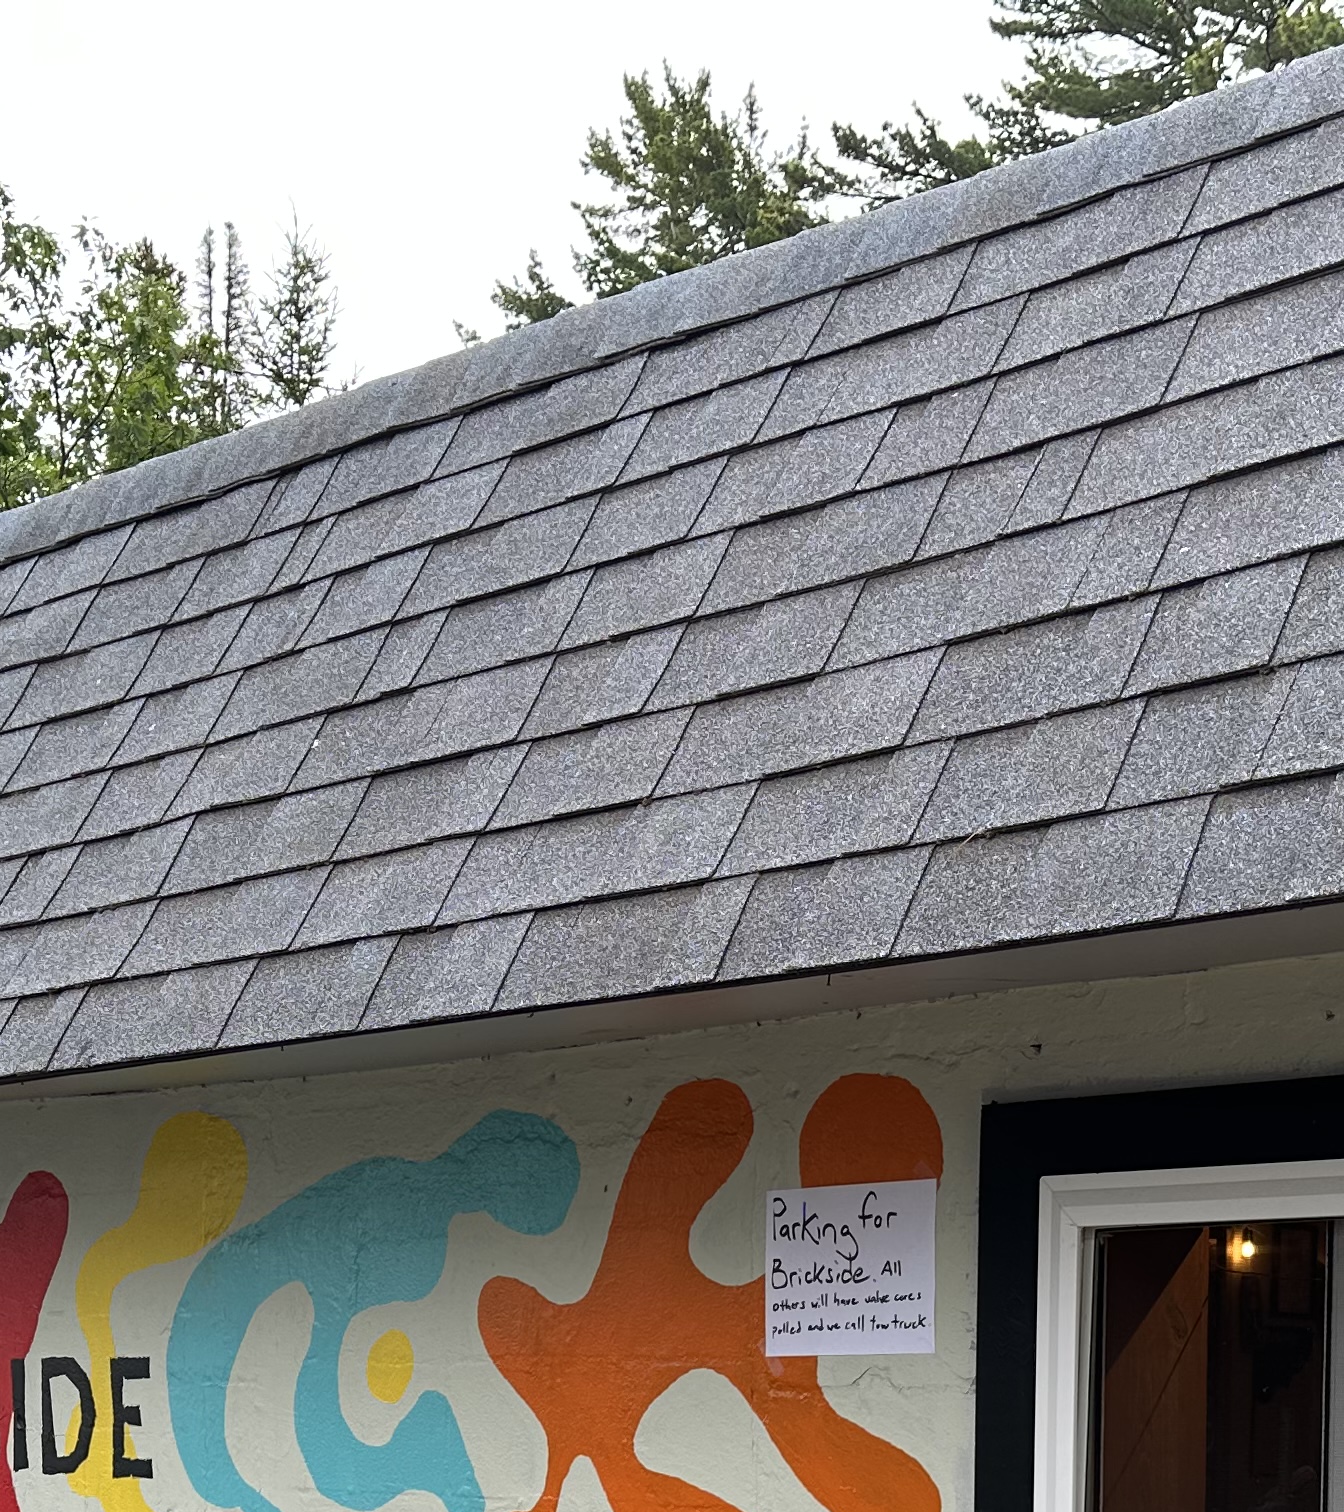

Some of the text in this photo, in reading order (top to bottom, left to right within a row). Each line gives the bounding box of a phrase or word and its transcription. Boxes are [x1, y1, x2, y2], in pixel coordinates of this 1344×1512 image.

[772, 1190, 897, 1261] Parking for
[881, 1260, 902, 1277] All
[811, 1293, 828, 1308] will
[833, 1292, 859, 1307] have
[807, 1318, 824, 1332] and
[827, 1322, 841, 1332] we
[844, 1314, 865, 1332] call
